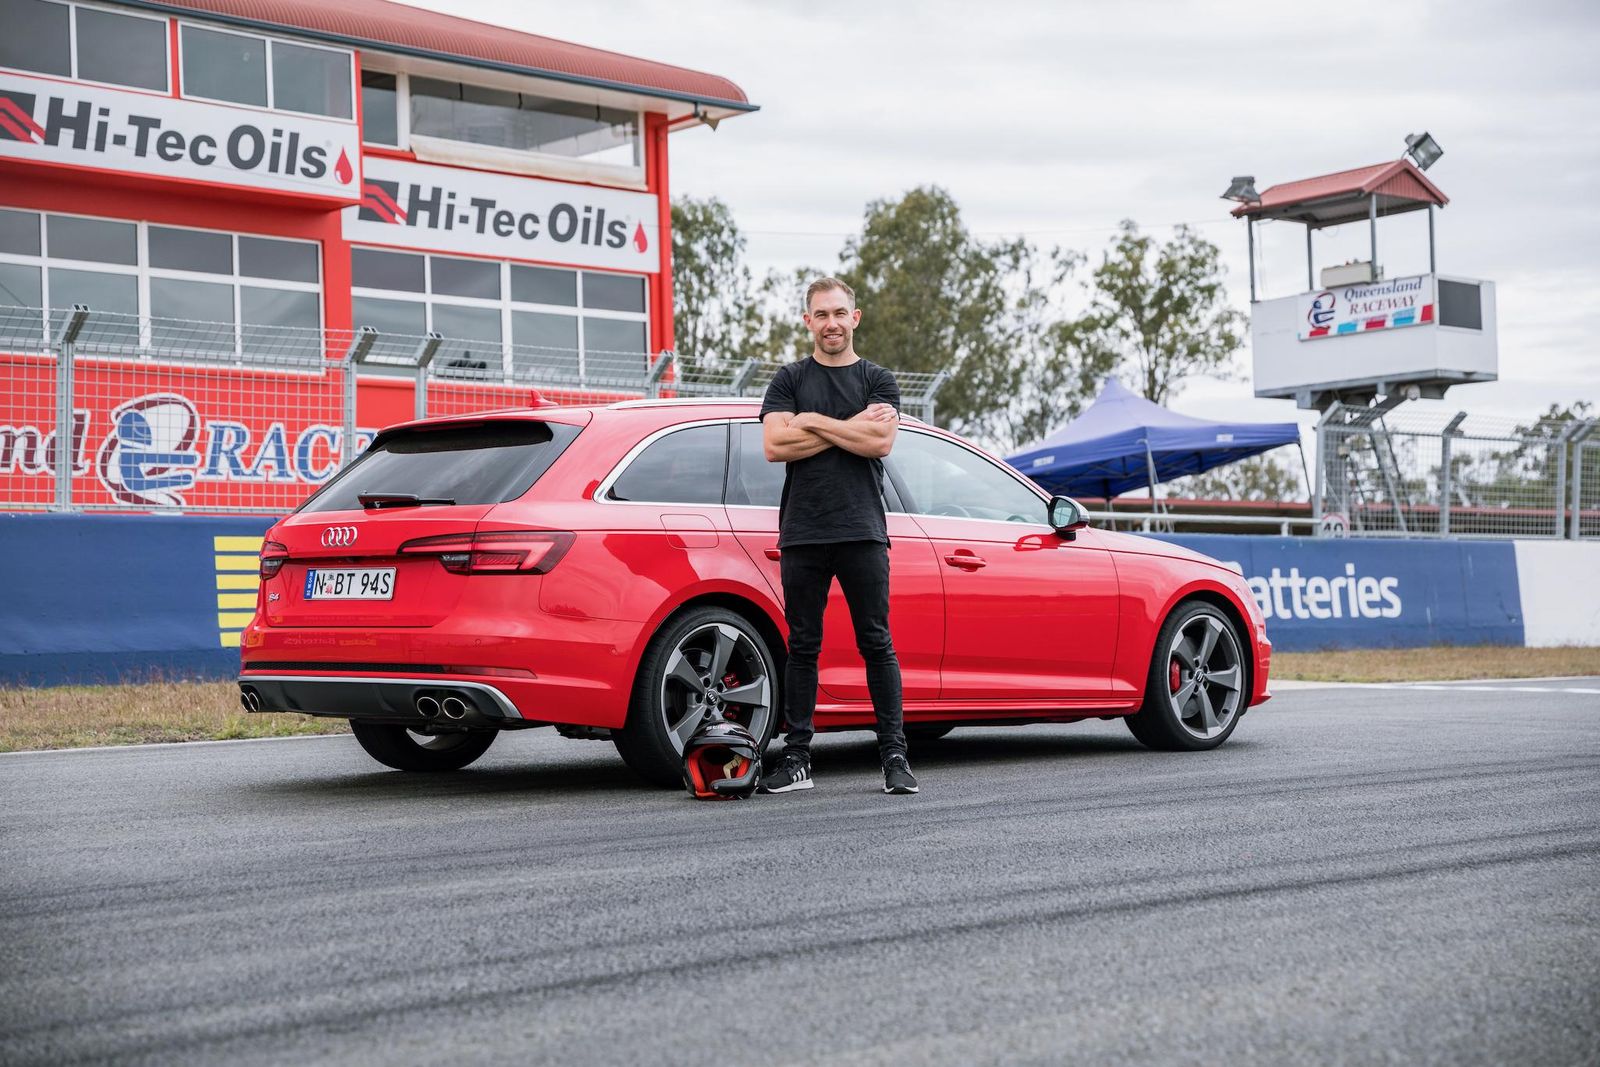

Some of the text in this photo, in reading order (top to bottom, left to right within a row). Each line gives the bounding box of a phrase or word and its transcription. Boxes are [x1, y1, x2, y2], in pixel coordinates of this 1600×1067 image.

[44, 96, 328, 179] Hi-Tec Oils
[405, 184, 628, 249] Hi-Tec Oils
[1344, 276, 1422, 302] Queensland
[1349, 294, 1418, 315] RACEWAY
[361, 573, 391, 595] 94S
[1223, 561, 1402, 619] atteries
